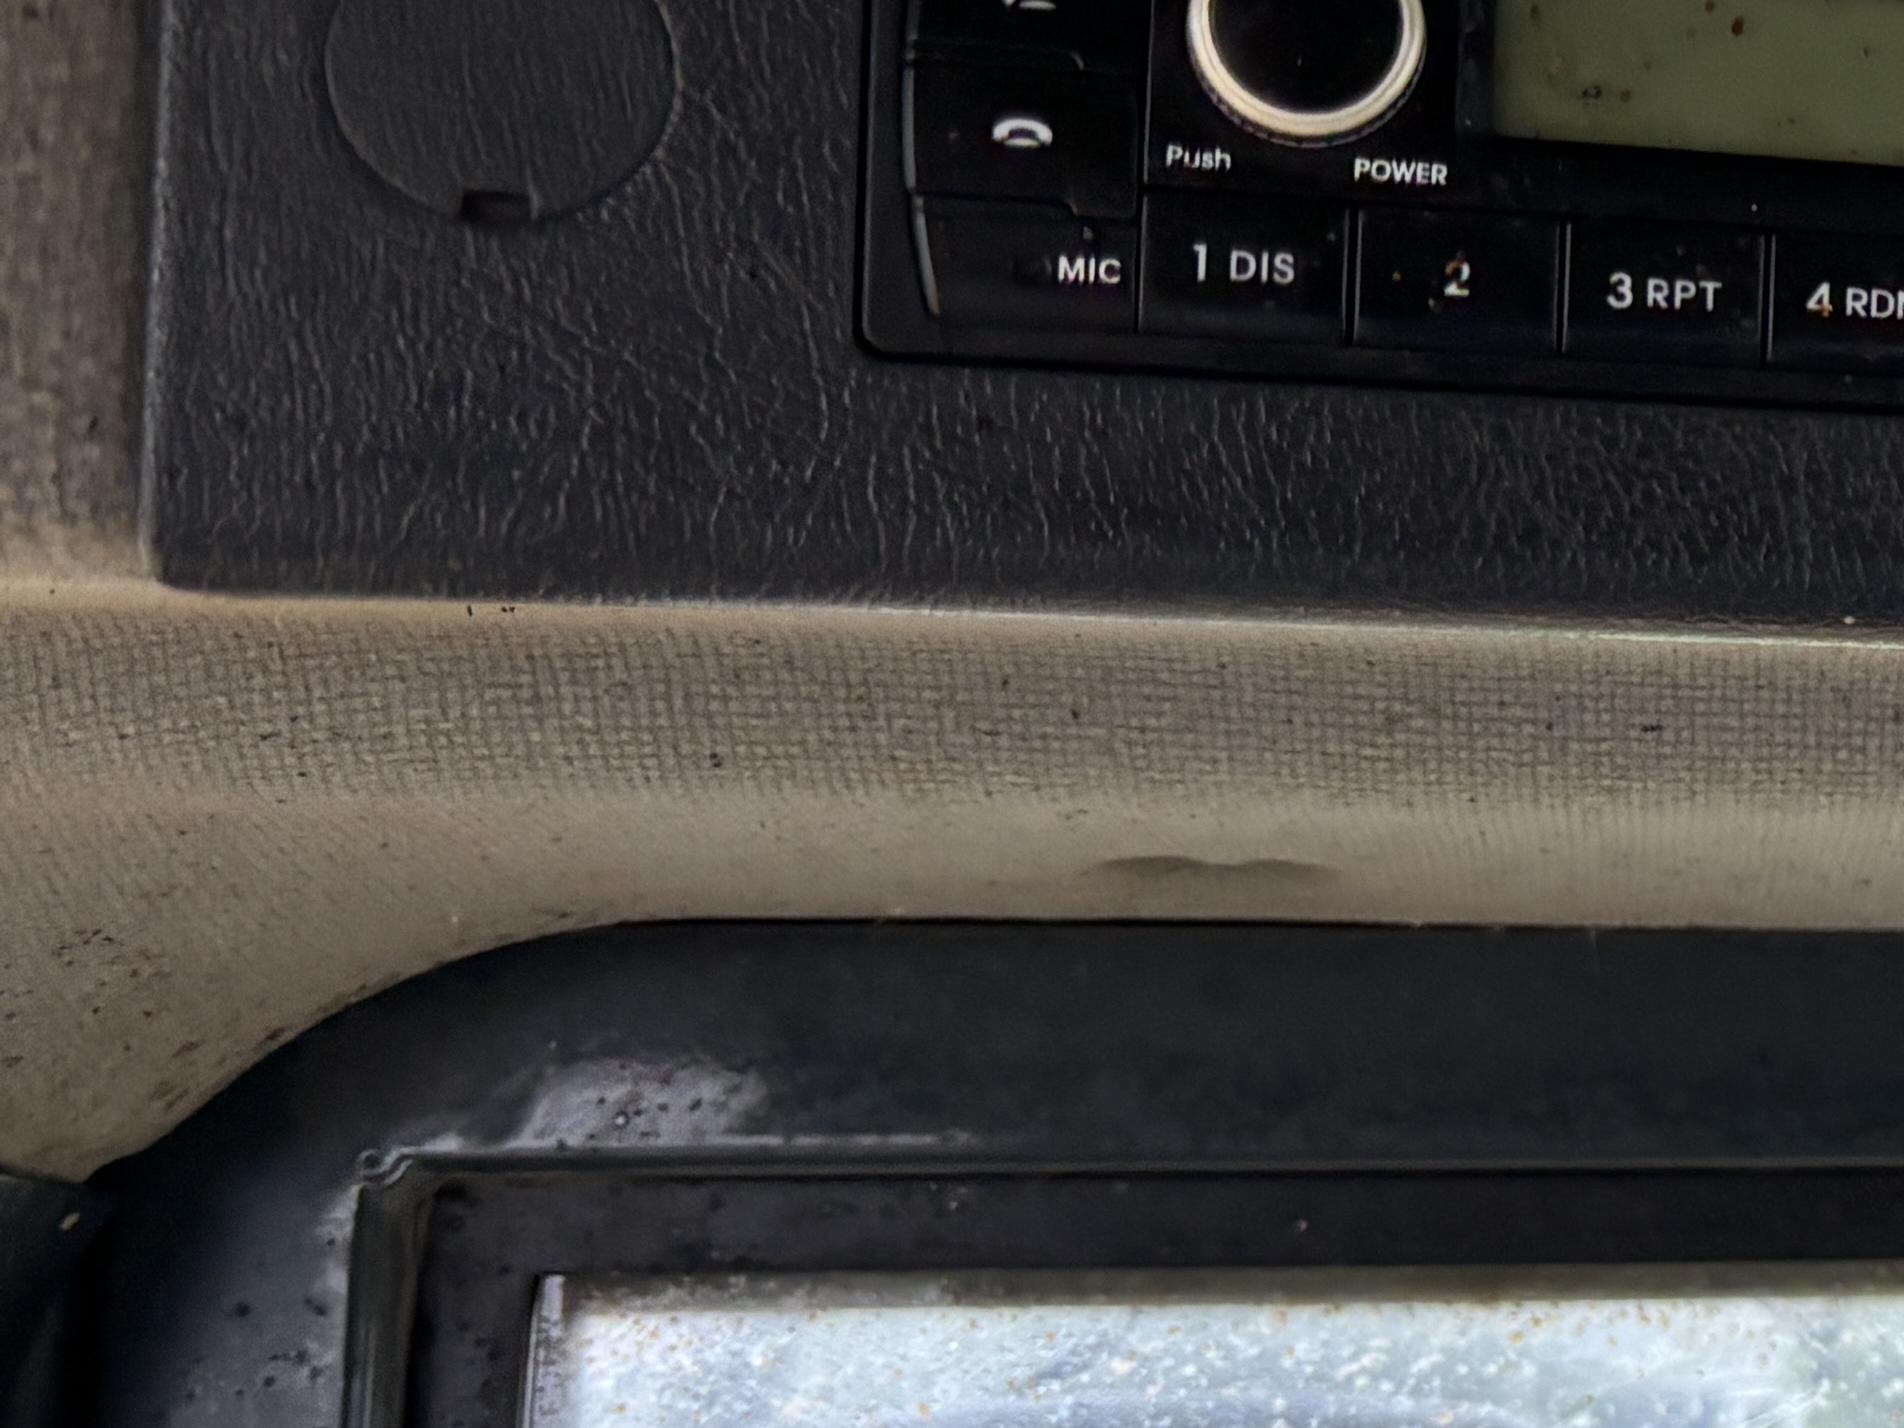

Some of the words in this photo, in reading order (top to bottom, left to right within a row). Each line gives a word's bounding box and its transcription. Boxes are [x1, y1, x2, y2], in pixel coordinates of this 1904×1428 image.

[1164, 143, 1233, 171] Push
[1352, 156, 1449, 186] POWER
[1056, 253, 1122, 285] MIC
[1192, 242, 1208, 283] 1
[1228, 248, 1296, 285] DIS
[1443, 261, 1472, 297] 2
[1605, 270, 1635, 310] 3
[1645, 276, 1723, 312] RPT
[1805, 281, 1834, 317] 4
